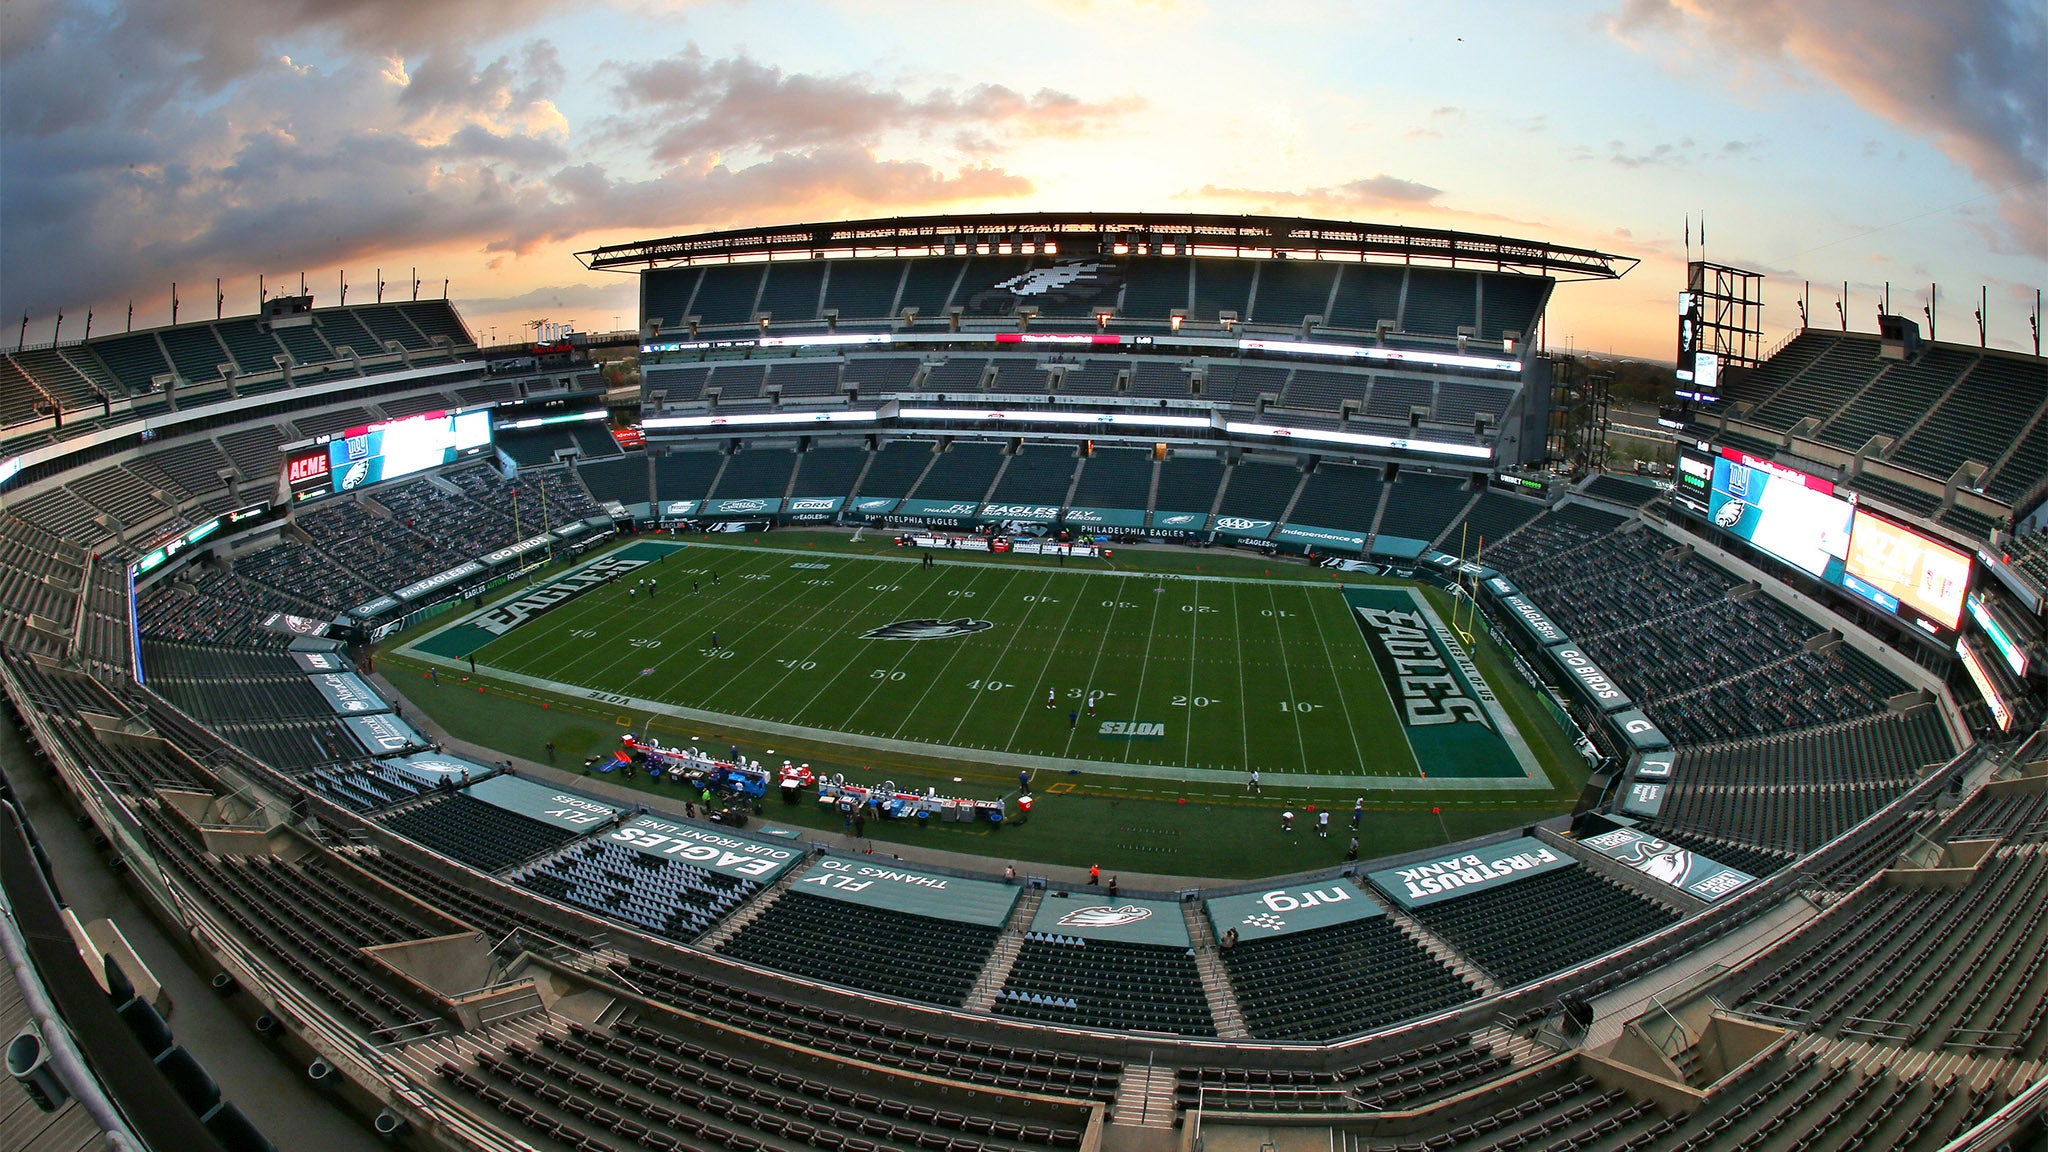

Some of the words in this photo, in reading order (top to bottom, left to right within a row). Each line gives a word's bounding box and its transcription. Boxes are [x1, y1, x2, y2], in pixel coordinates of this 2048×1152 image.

[289, 455, 326, 481] ACME
[1500, 474, 1522, 486] UNIBET
[795, 500, 831, 510] TORK
[982, 505, 1060, 515] EAGLES
[926, 517, 959, 526] EAGLES
[1081, 525, 1146, 536] PHILADELPHIA
[1150, 528, 1184, 538] EAGLES
[1281, 528, 1350, 542] Independence
[490, 549, 512, 561] GO
[515, 536, 548, 553] BIRDS
[462, 557, 650, 637] EAGLES
[464, 585, 486, 600] EAGLES
[948, 589, 976, 598] 50
[370, 598, 391, 610] pepsi
[870, 669, 907, 682] 50
[1355, 606, 1493, 733] EAGLES
[1441, 633, 1467, 658] TAKES
[1456, 657, 1477, 675] ALL
[1469, 675, 1486, 688] OF
[1480, 690, 1496, 703] US
[1560, 650, 1586, 666] GO
[1574, 665, 1619, 699] BIRDS
[965, 678, 1004, 692] 40
[1066, 686, 1105, 701] 30
[587, 690, 632, 706] VOTE
[1170, 694, 1210, 708] 20
[1279, 701, 1313, 714] 10
[361, 716, 394, 741] Lincoln
[1098, 720, 1165, 737] VOTES
[551, 794, 615, 816] HEROES
[544, 807, 600, 825] FLY
[635, 819, 679, 834] LINE
[675, 829, 744, 852] FRONT
[610, 827, 781, 878] EAGLES
[743, 843, 791, 860] OUR
[821, 860, 852, 873] TO
[1394, 853, 1484, 882] BANK
[802, 873, 876, 893] FLY
[856, 866, 949, 890] THANKS
[1695, 872, 1738, 893] LIGHT
[1710, 877, 1742, 894] BUD
[1261, 886, 1352, 913] nrg
